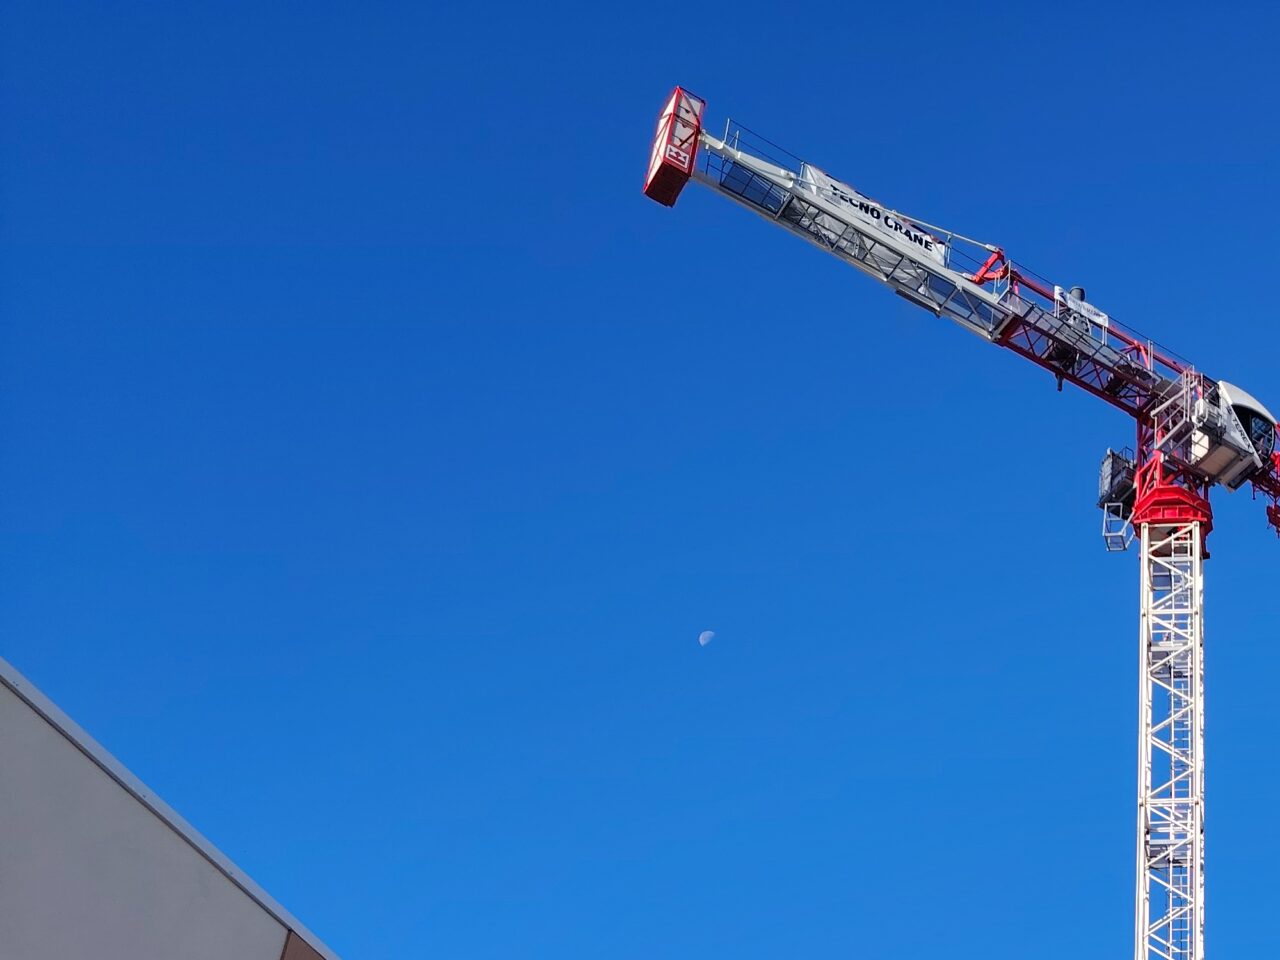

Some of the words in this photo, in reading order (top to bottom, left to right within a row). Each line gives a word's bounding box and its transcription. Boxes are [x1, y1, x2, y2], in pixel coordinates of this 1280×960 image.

[830, 184, 881, 220] TECNO
[883, 215, 933, 252] CRANE
[1232, 416, 1253, 450] TEREX
